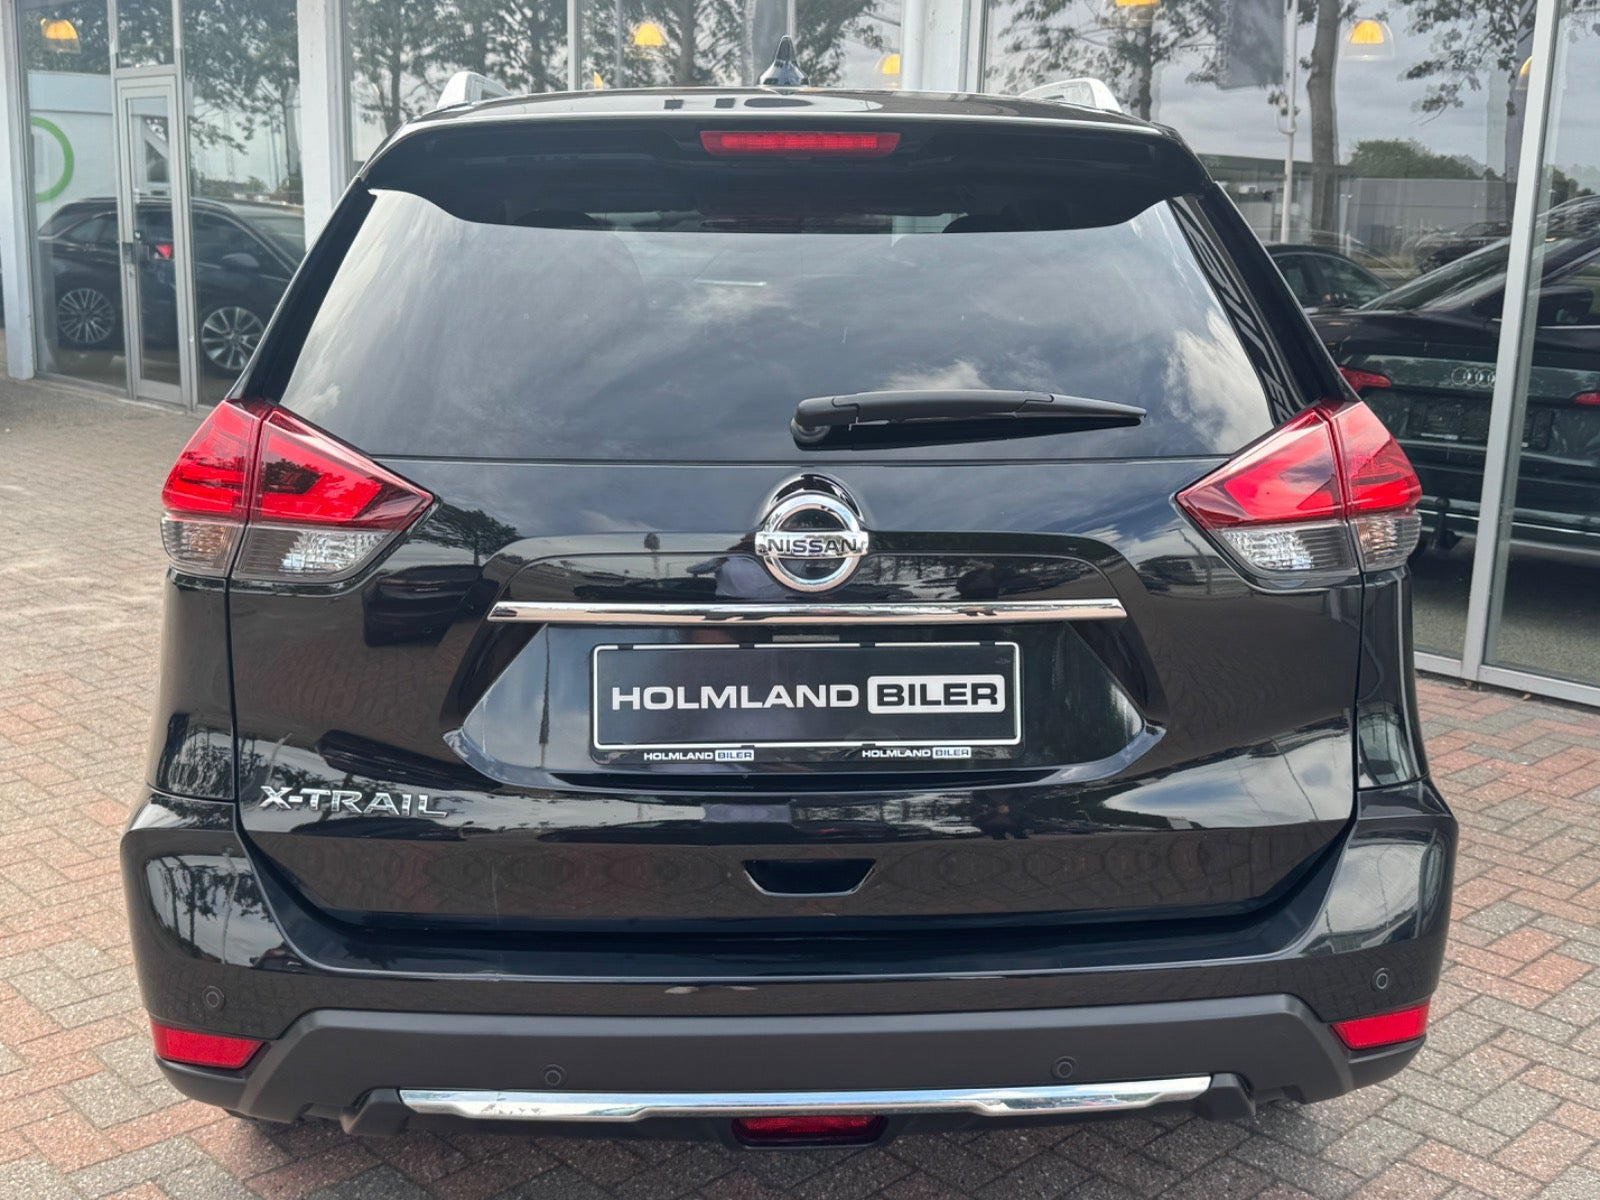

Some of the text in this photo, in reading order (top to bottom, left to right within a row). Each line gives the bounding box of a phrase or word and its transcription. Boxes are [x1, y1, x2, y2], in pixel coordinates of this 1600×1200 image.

[767, 538, 857, 553] NISSAN
[611, 682, 999, 710] HOLMLAND BILER
[643, 751, 753, 761] HOLMLAND BILER
[861, 748, 970, 758] HOLMLAND BILER
[259, 785, 449, 818] X-TRAIL
